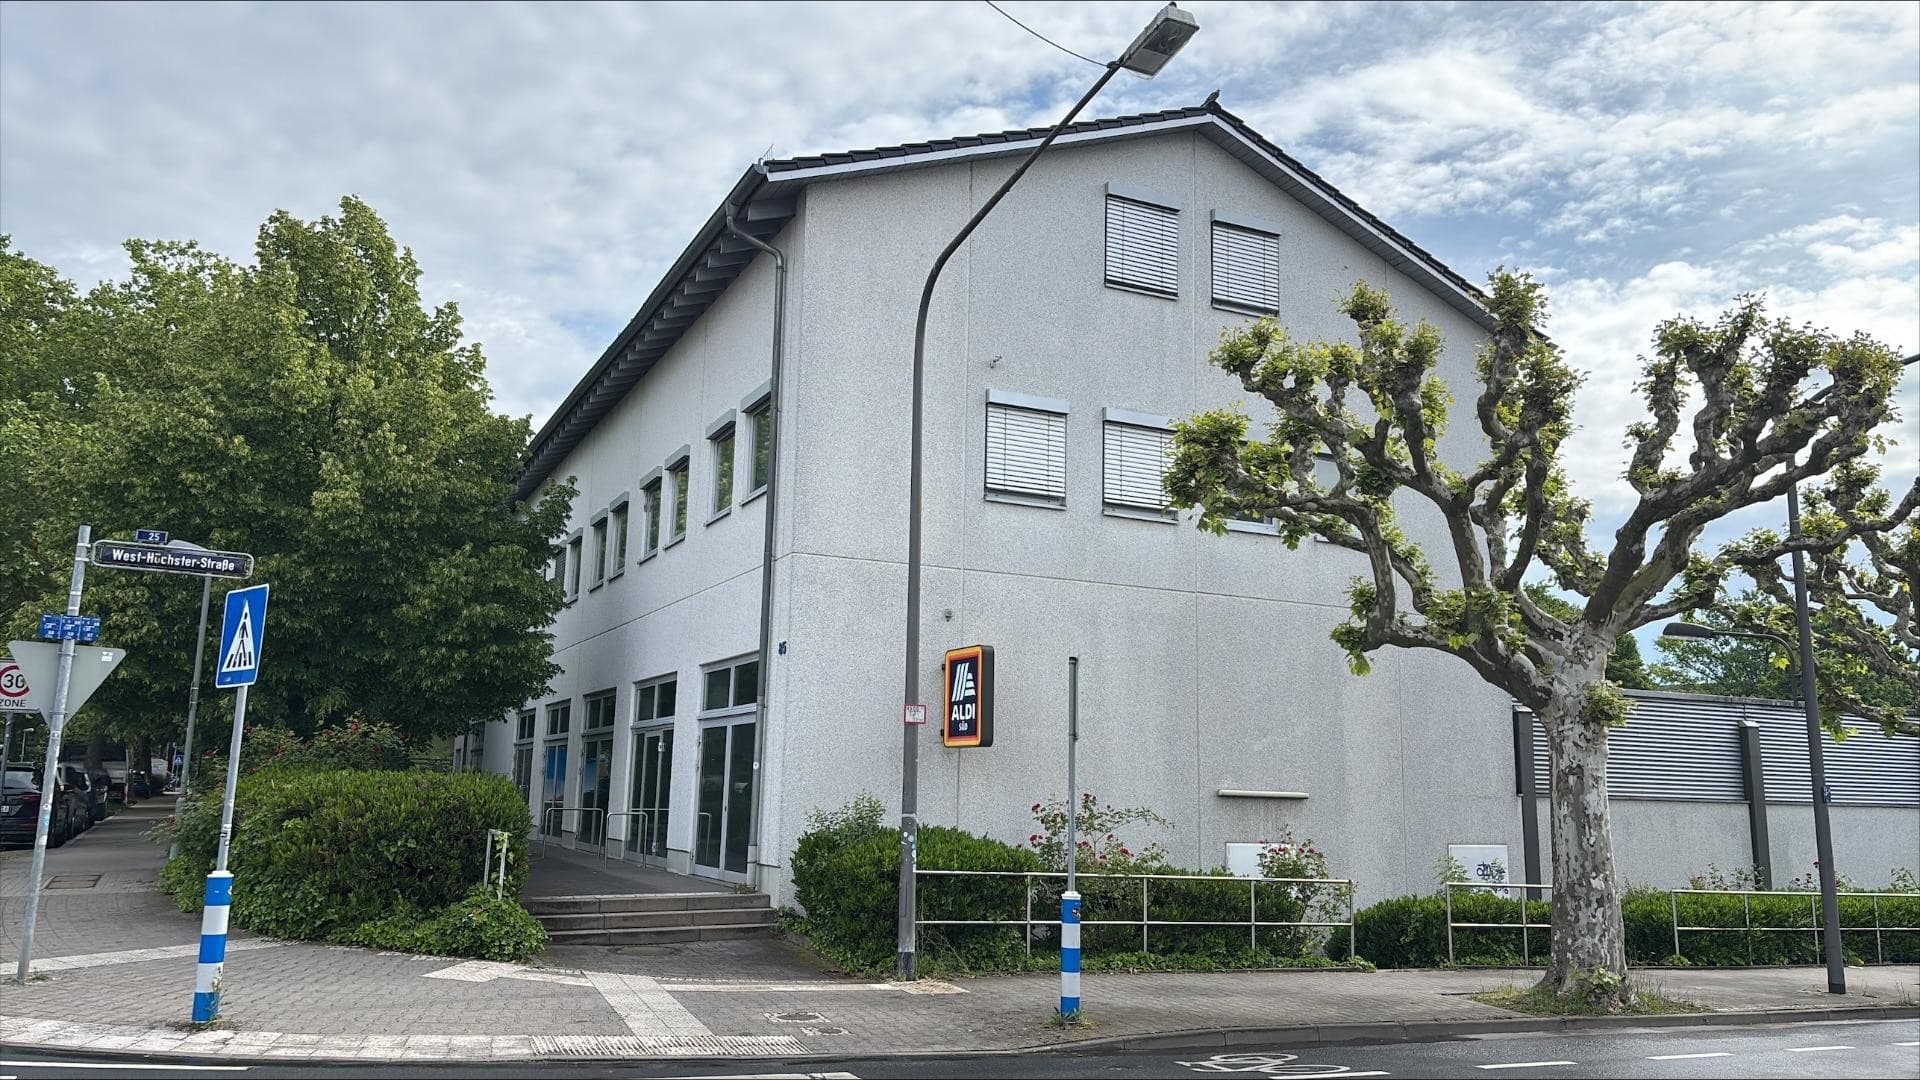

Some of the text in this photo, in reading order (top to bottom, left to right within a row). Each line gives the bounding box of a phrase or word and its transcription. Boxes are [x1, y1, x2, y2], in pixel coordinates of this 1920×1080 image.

[148, 532, 160, 541] 25
[3, 673, 25, 689] 30
[951, 703, 976, 721] ALDI
